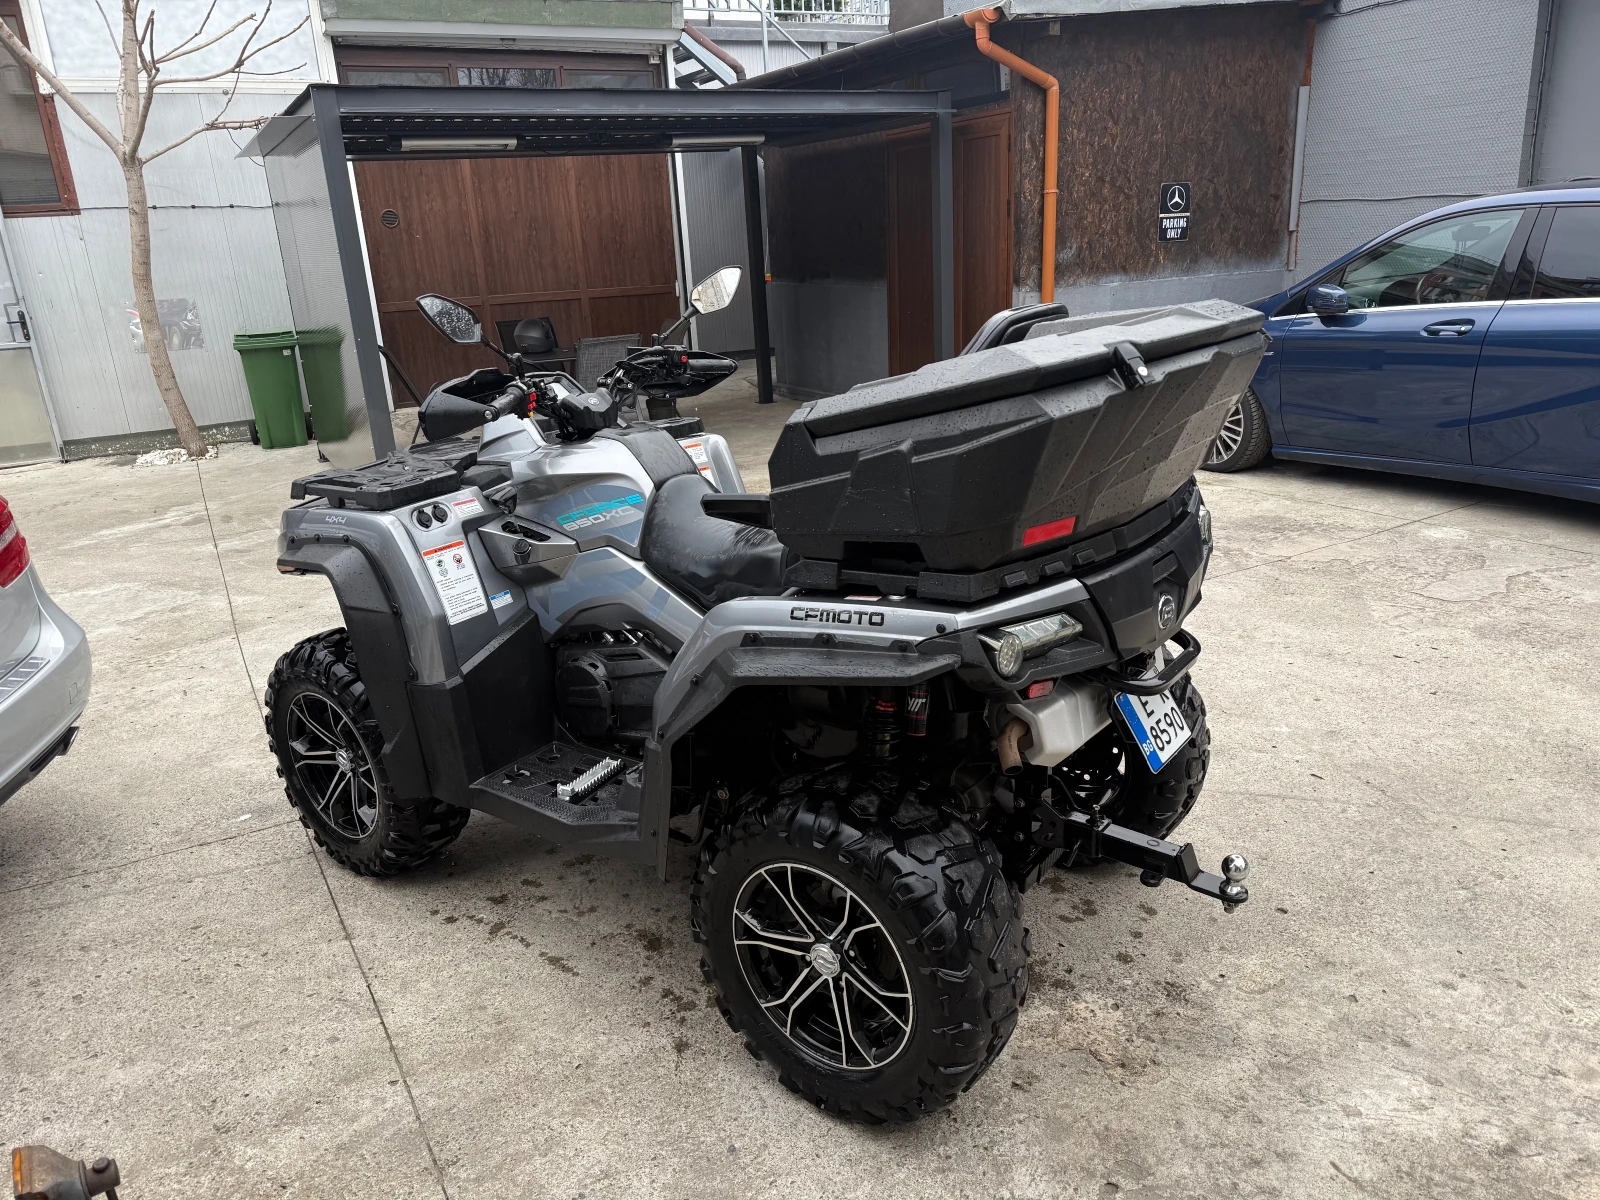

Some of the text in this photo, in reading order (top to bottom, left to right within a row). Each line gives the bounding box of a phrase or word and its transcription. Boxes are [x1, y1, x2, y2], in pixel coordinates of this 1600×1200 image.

[1162, 218, 1186, 228] PARKING
[1166, 228, 1182, 238] ONLY
[556, 493, 644, 525] CFORCE
[562, 505, 635, 531] 850XC
[789, 606, 885, 627] CFMOTO
[1149, 706, 1185, 752] 8590
[1142, 739, 1154, 756] BG
